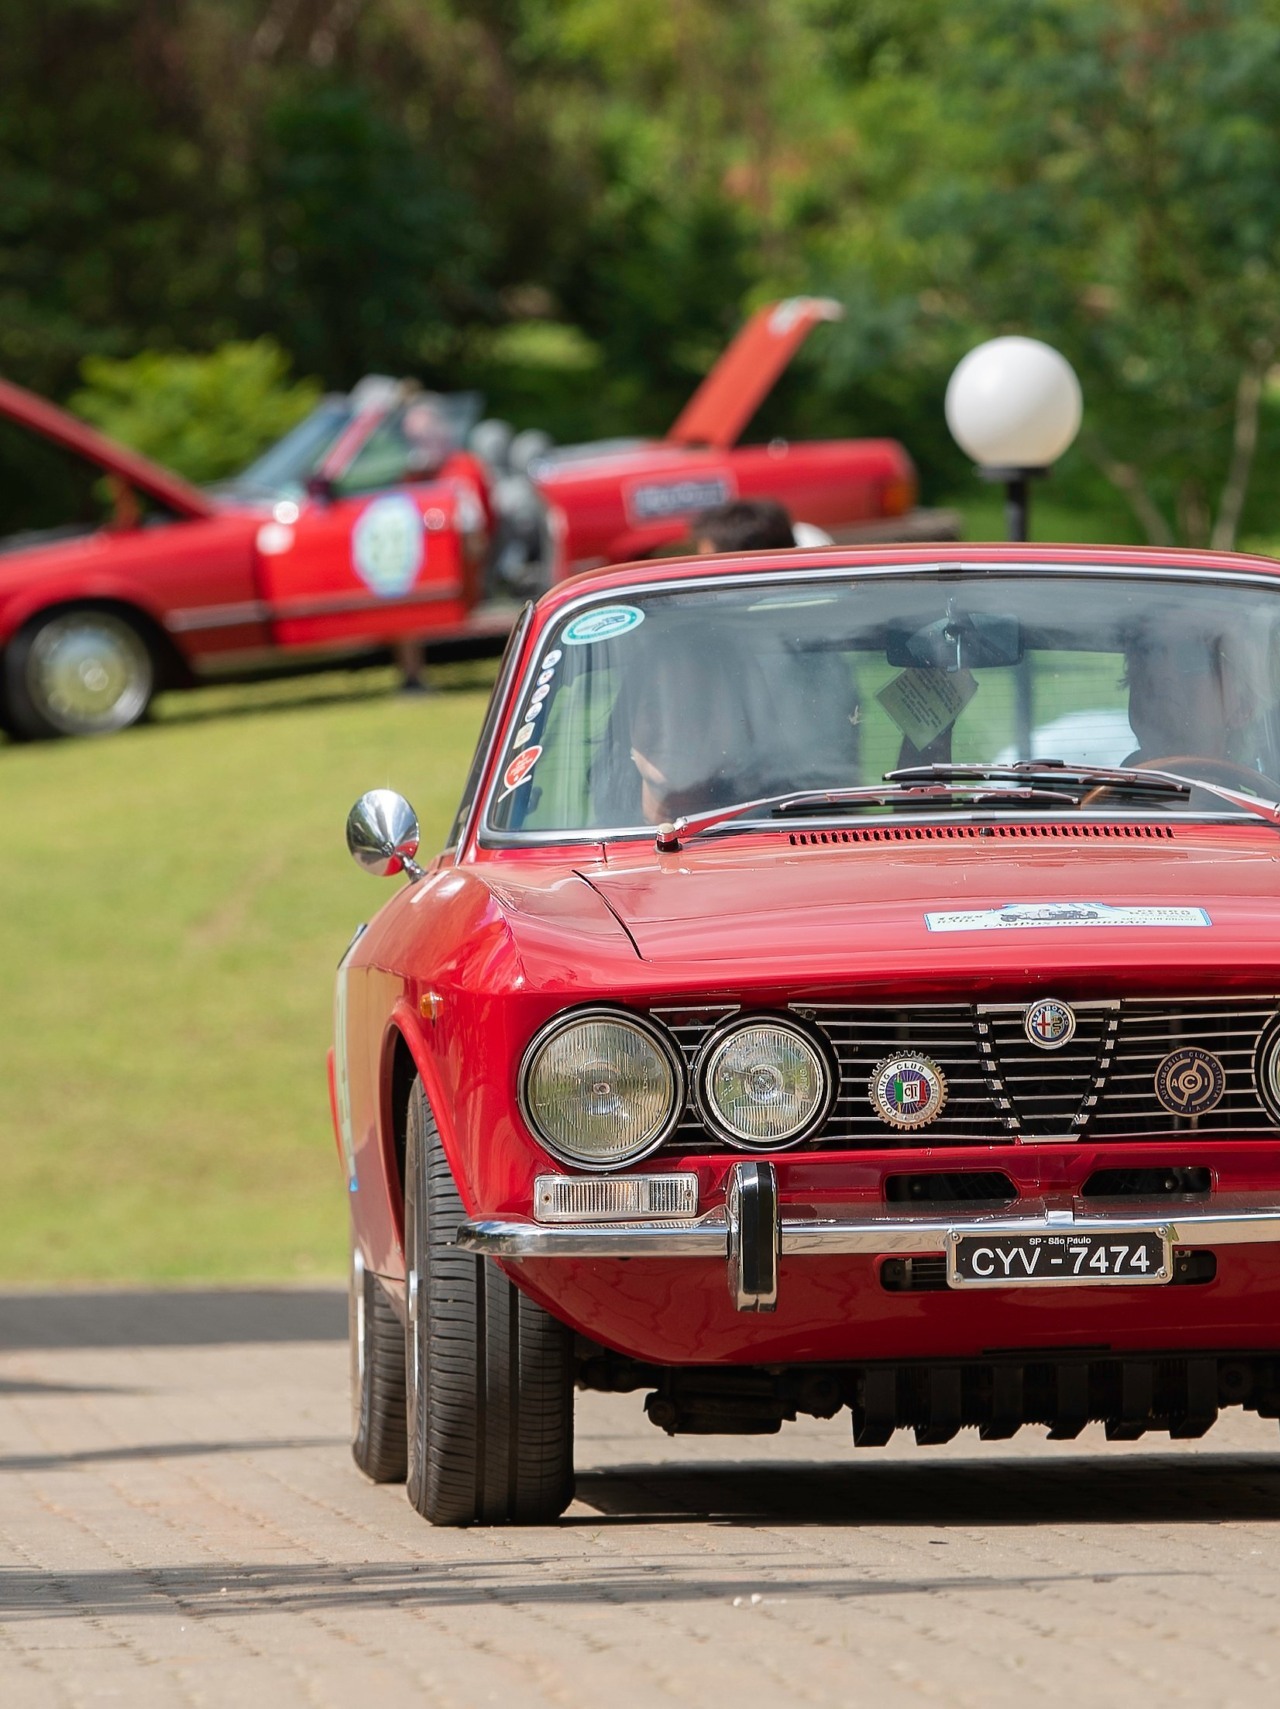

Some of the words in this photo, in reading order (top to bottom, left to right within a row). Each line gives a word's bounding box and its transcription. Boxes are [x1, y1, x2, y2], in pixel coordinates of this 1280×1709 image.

[1188, 1051, 1210, 1062] CLUB
[878, 1073, 898, 1119] TOURING
[896, 1062, 925, 1073] CLUB
[1029, 1237, 1042, 1246] SP
[1048, 1236, 1066, 1245] São
[1066, 1236, 1092, 1245] Paulo
[971, 1247, 1042, 1276] CYV
[1069, 1245, 1151, 1274] 7474
